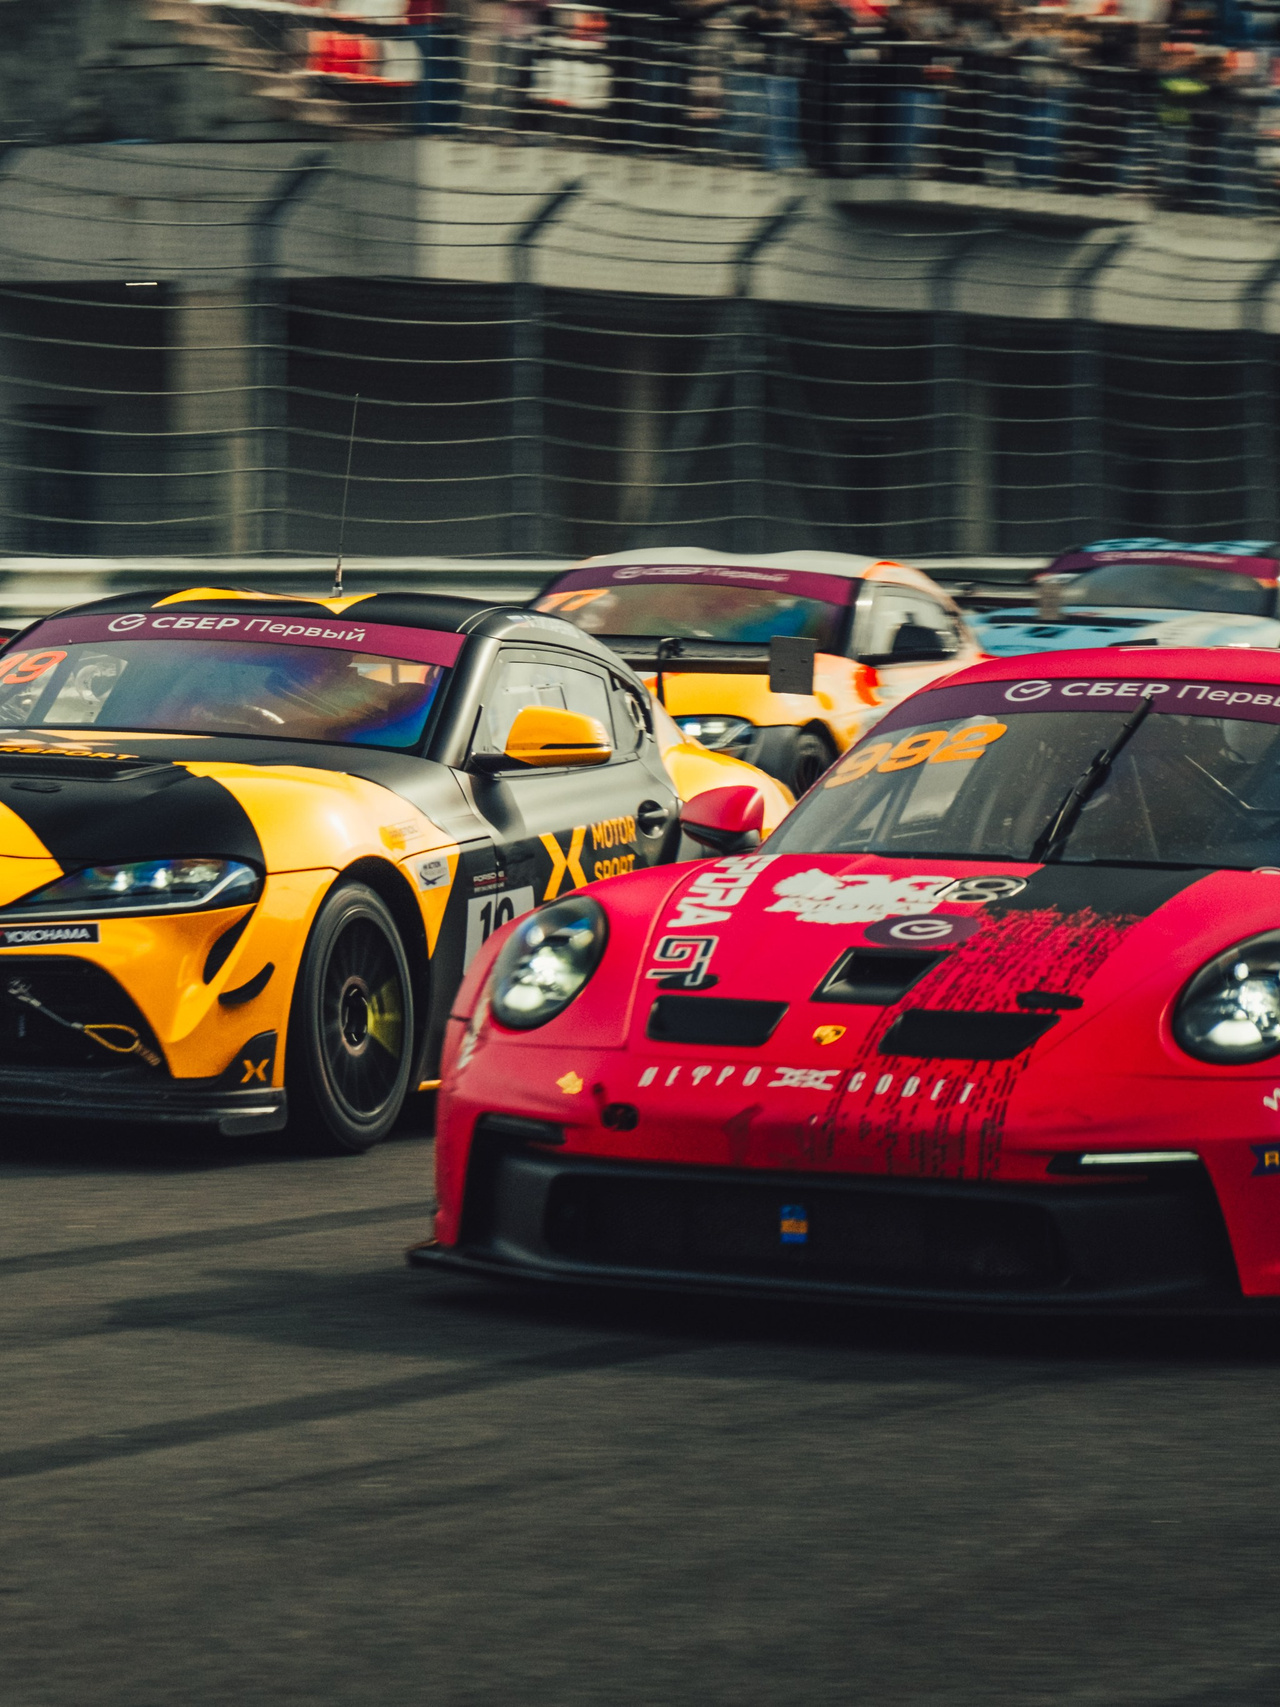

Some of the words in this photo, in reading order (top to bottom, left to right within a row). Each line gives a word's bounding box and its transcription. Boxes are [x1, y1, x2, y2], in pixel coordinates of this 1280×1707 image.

[151, 617, 240, 630] СБЕР
[244, 618, 367, 642] Первый
[1061, 682, 1170, 698] СБЕР
[823, 722, 1008, 789] 992
[590, 815, 637, 851] MOTOR
[4, 928, 91, 943] YOKOHAMA
[645, 935, 720, 986] GT
